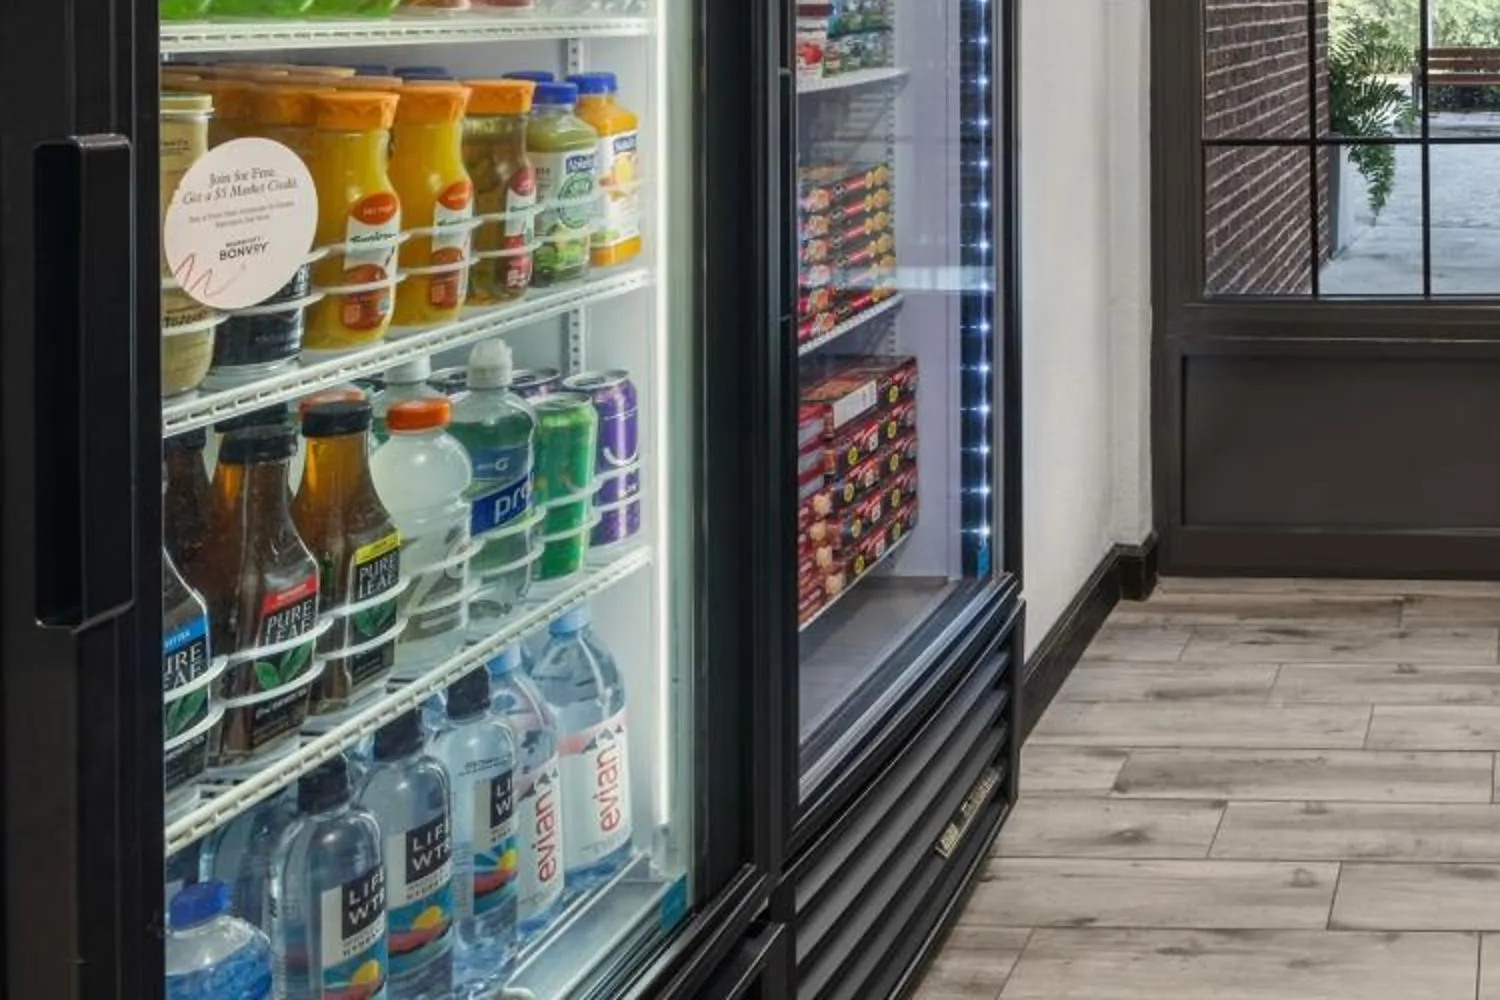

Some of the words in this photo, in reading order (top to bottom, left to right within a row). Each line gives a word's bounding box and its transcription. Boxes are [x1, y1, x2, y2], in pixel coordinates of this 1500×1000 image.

[359, 555, 398, 582] PURE
[266, 599, 314, 632] PURE
[591, 742, 620, 834] evian
[534, 782, 556, 885] evian
